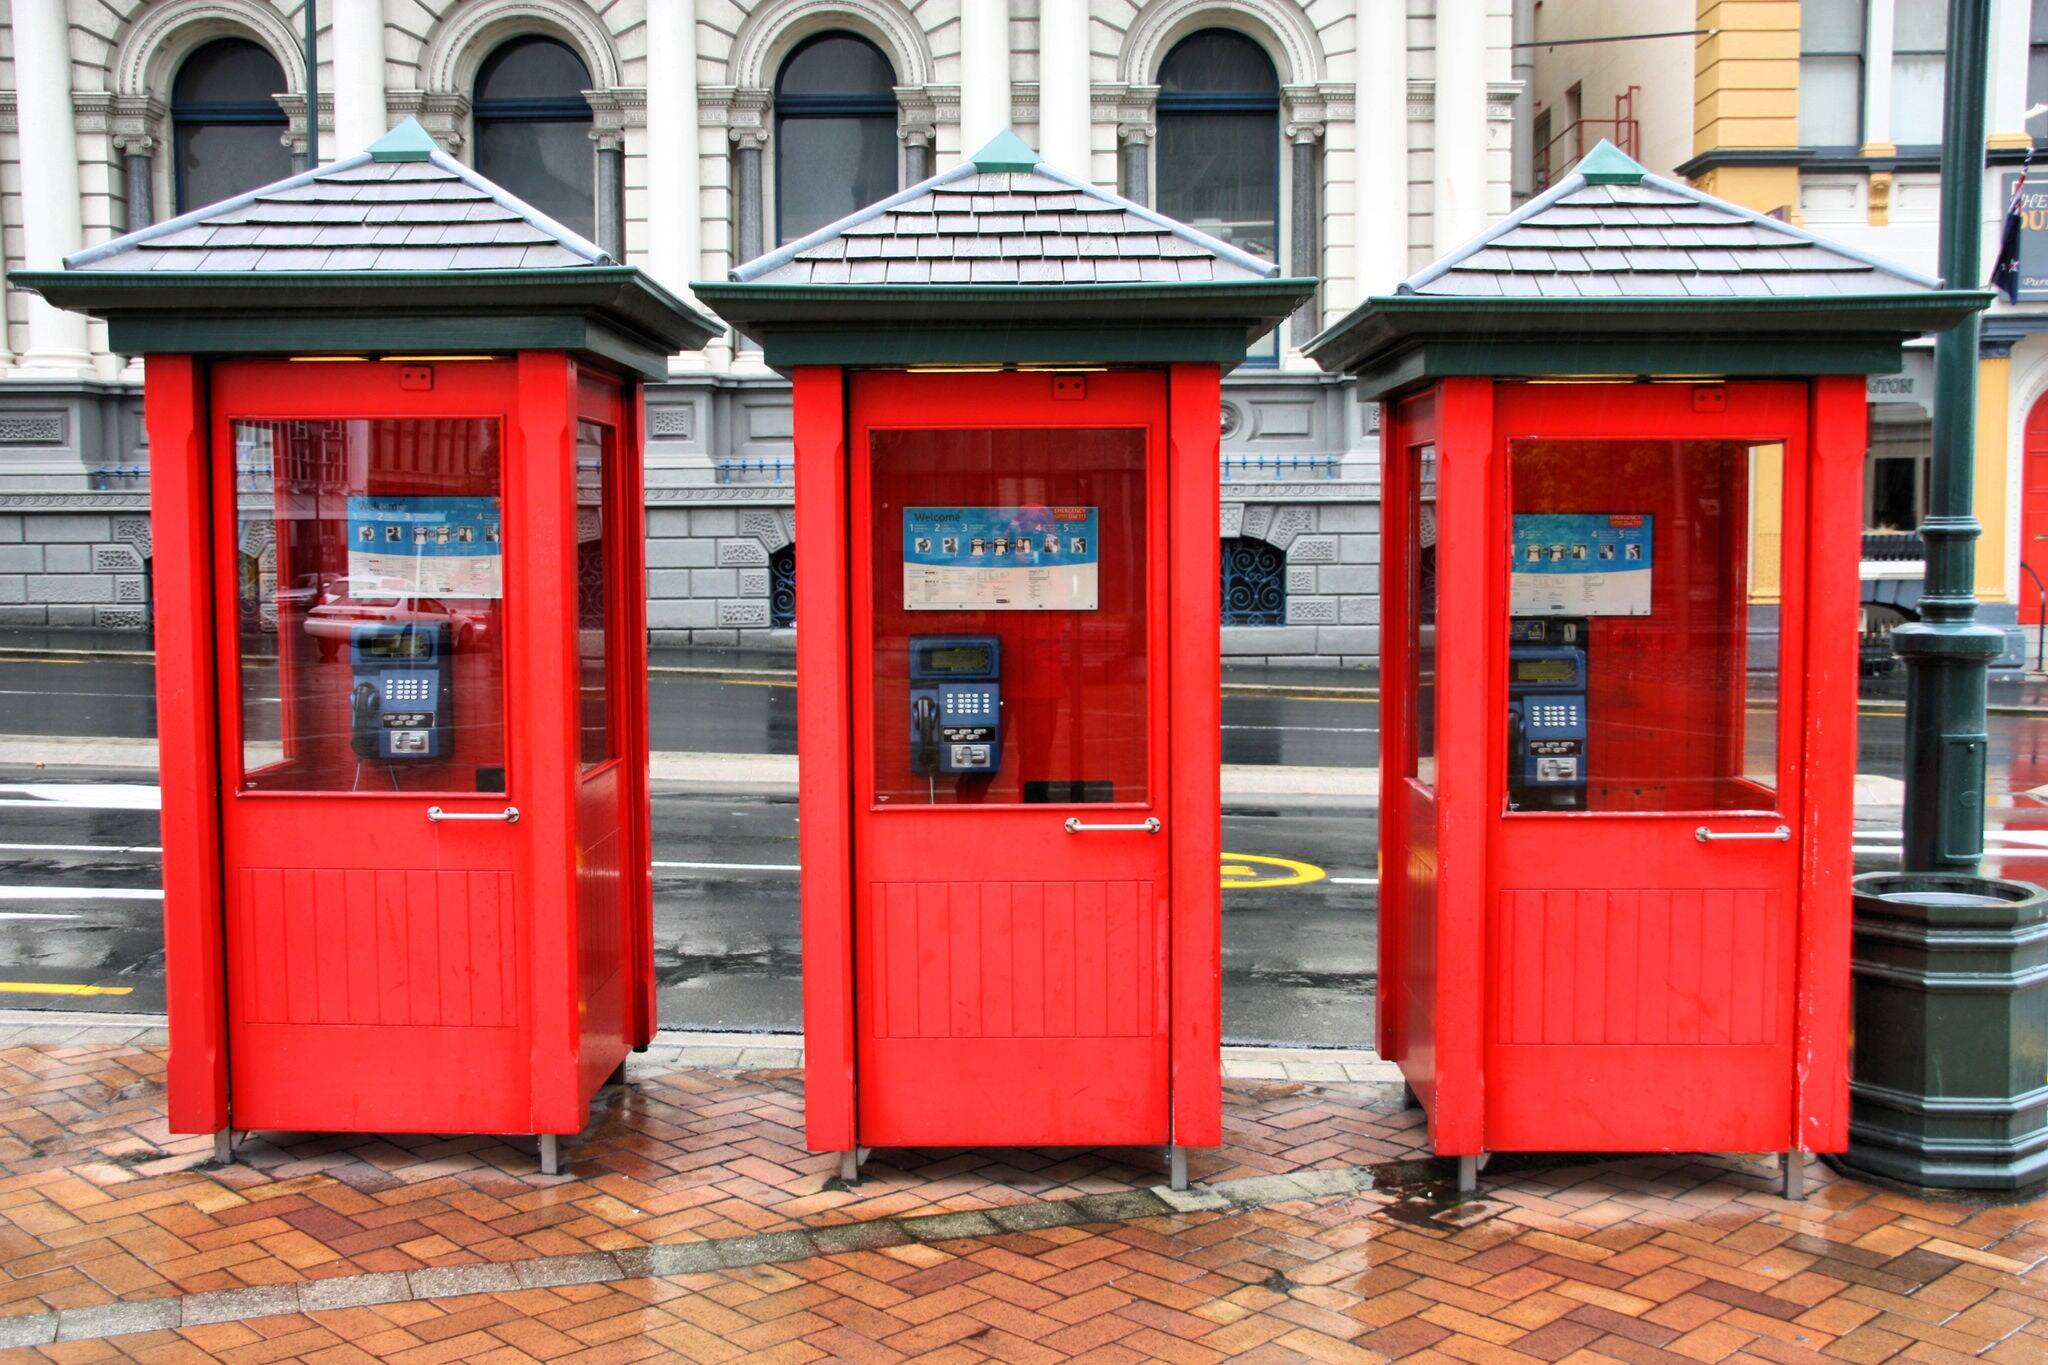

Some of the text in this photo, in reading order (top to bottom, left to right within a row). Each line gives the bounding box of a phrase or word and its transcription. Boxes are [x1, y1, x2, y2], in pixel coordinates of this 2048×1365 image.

[2018, 193, 2048, 208] HE
[2020, 209, 2048, 230] DU
[361, 501, 405, 511] Welcome
[914, 512, 960, 521] Welcome
[934, 523, 940, 532] 2
[962, 523, 968, 532] 3
[1063, 523, 1069, 532] 5
